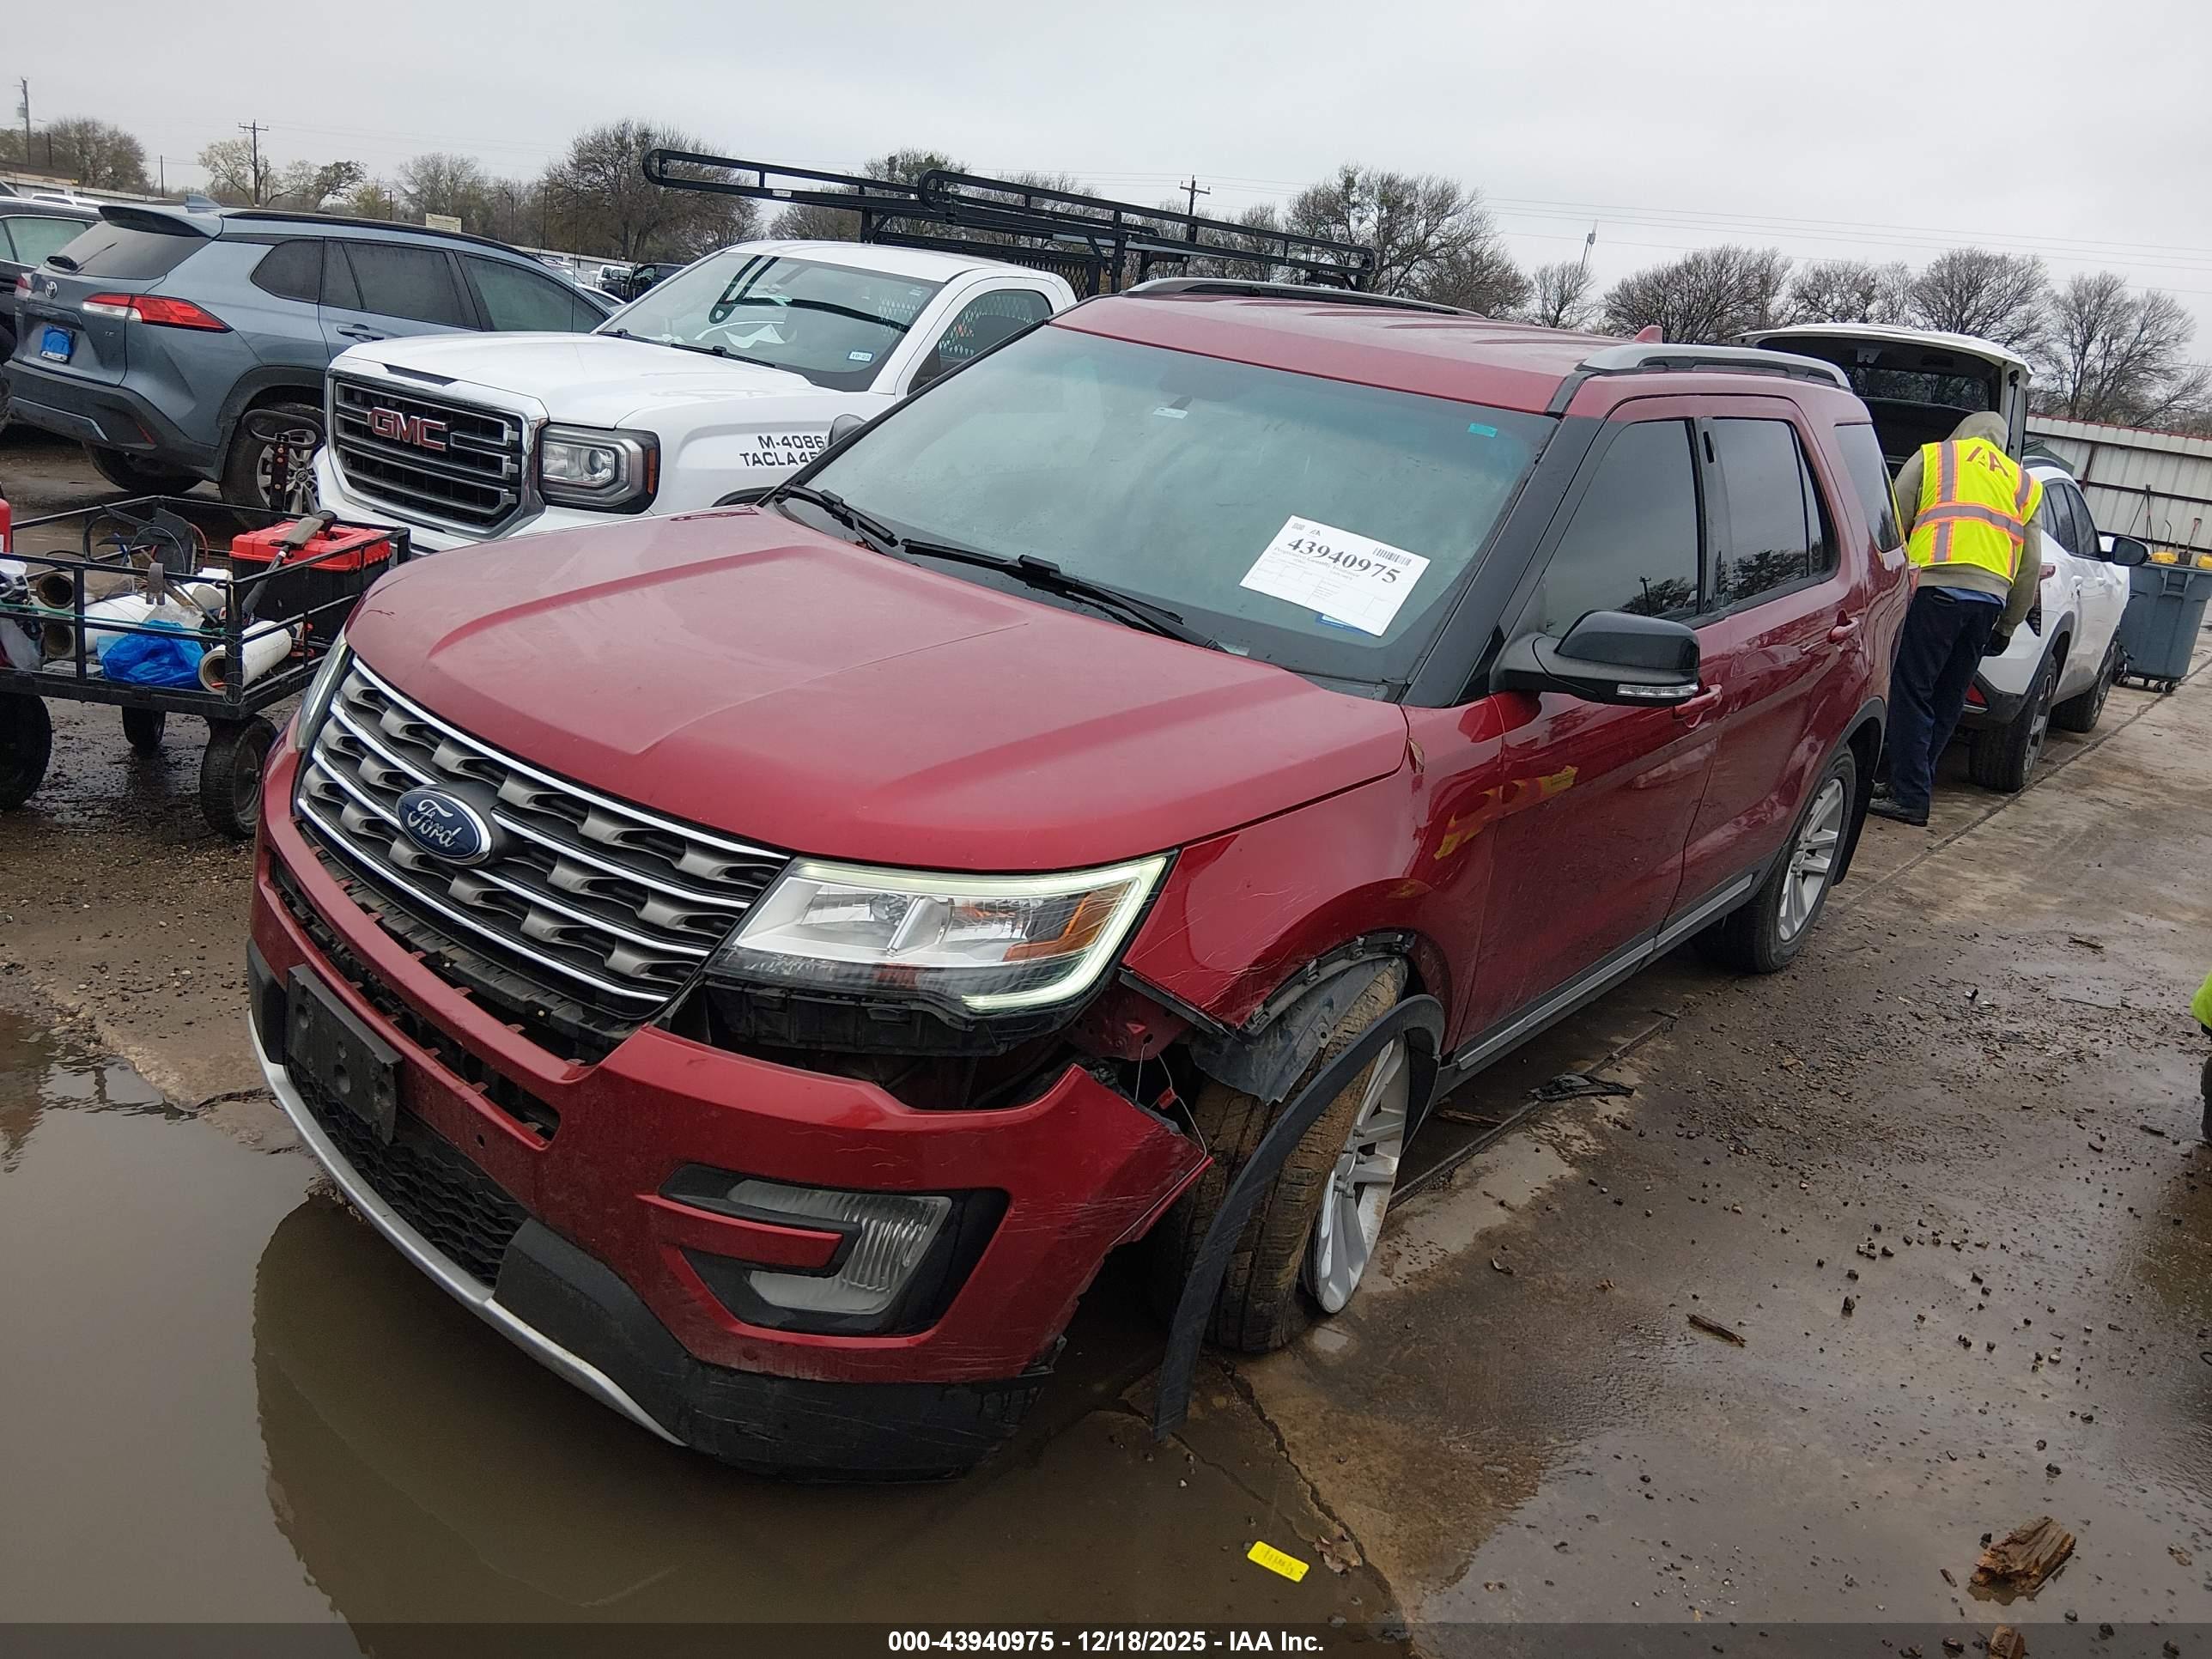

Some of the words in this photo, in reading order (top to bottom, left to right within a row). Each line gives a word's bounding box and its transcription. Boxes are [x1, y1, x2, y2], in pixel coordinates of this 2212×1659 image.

[371, 406, 447, 452] GMC
[757, 435, 826, 448] M-4086
[1288, 538, 1401, 583] 43940975
[407, 799, 463, 848] Ford
